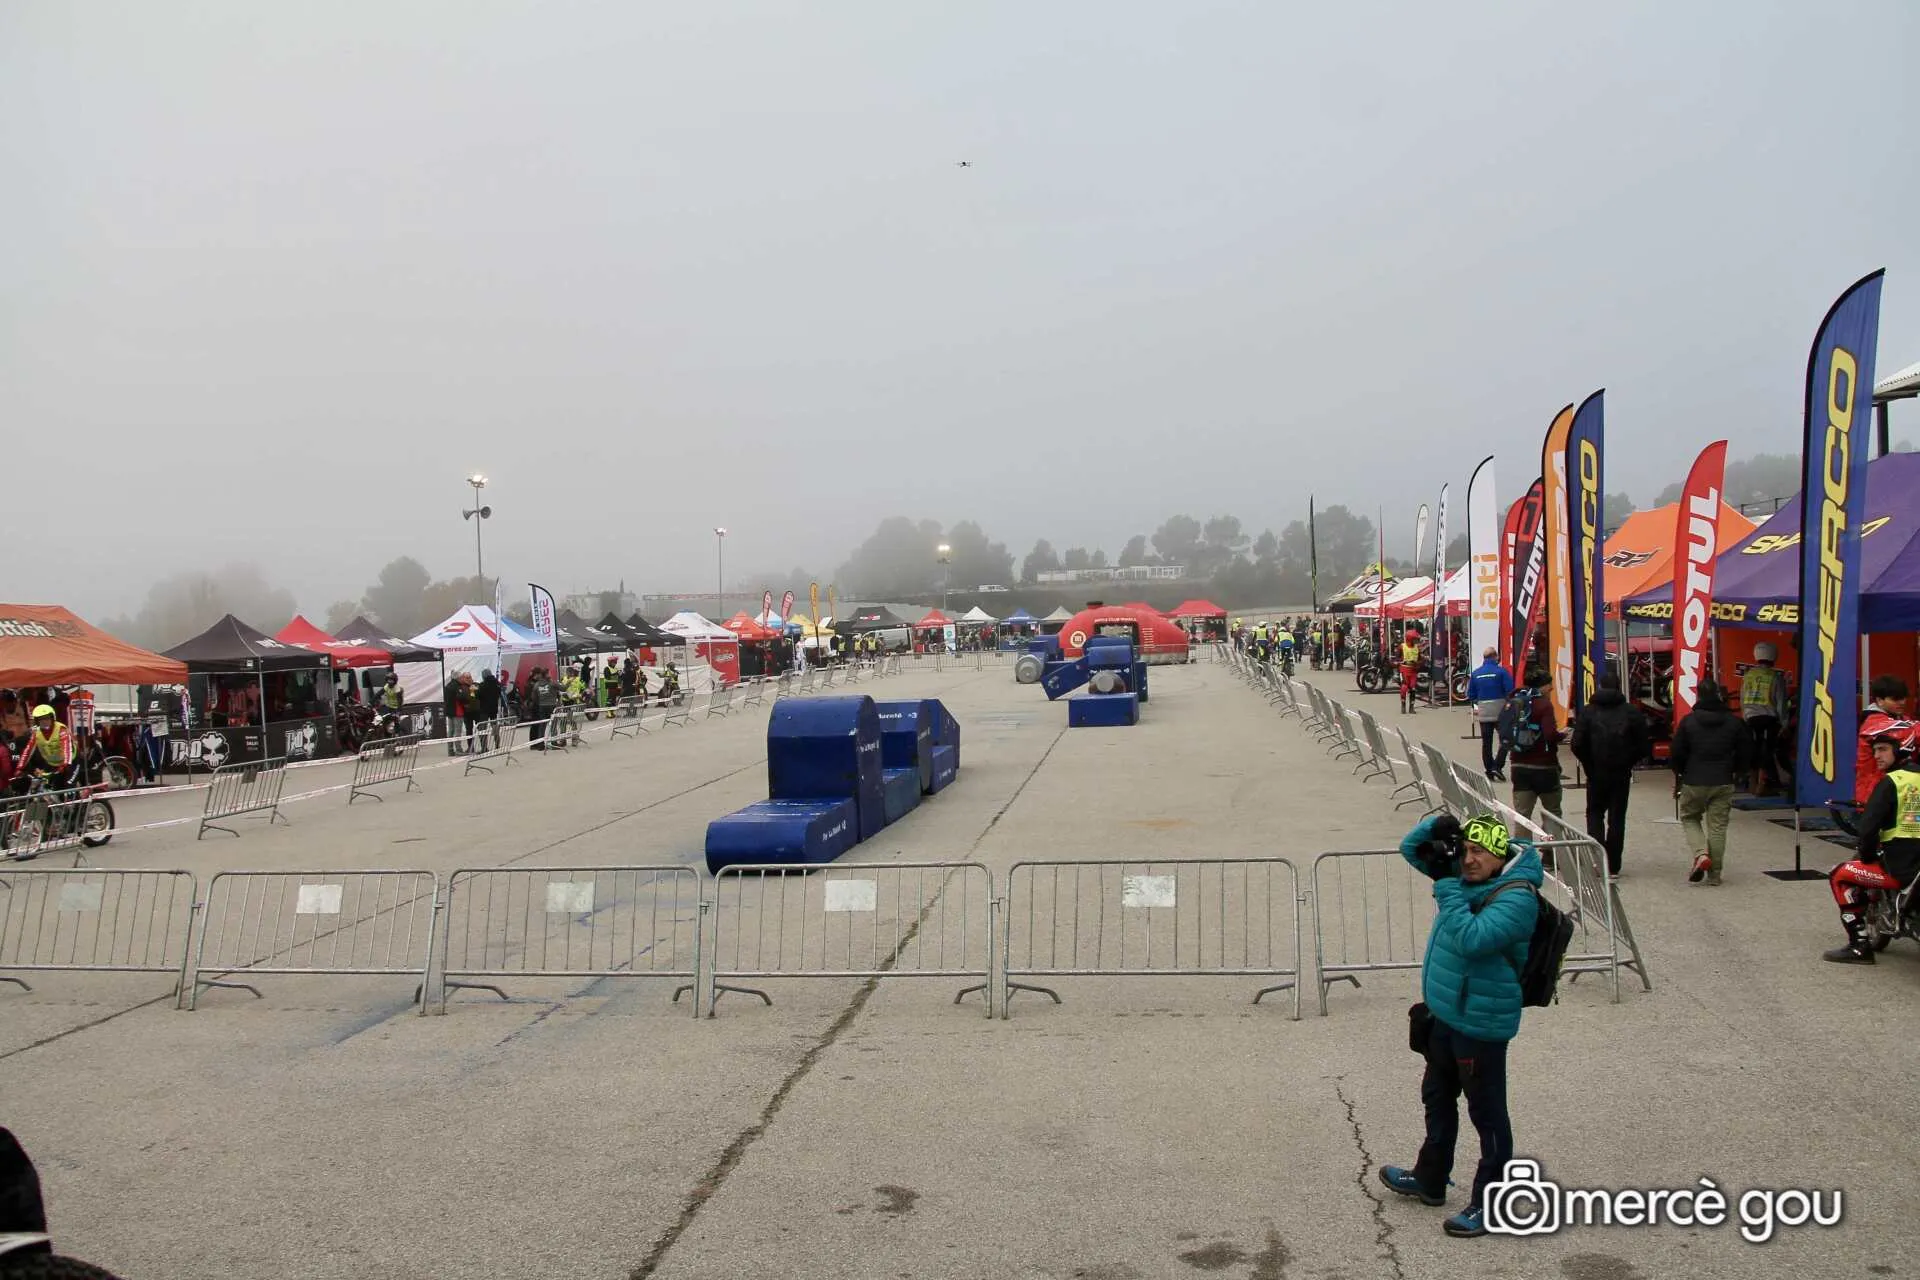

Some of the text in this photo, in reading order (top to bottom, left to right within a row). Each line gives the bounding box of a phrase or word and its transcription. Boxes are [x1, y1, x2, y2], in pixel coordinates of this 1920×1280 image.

[1579, 438, 1599, 705] SHERCO
[1678, 487, 1719, 708] MOTUL
[1757, 604, 1799, 623] SHE
[1811, 347, 1857, 782] SHERCO
[1845, 863, 1885, 880] Montesa
